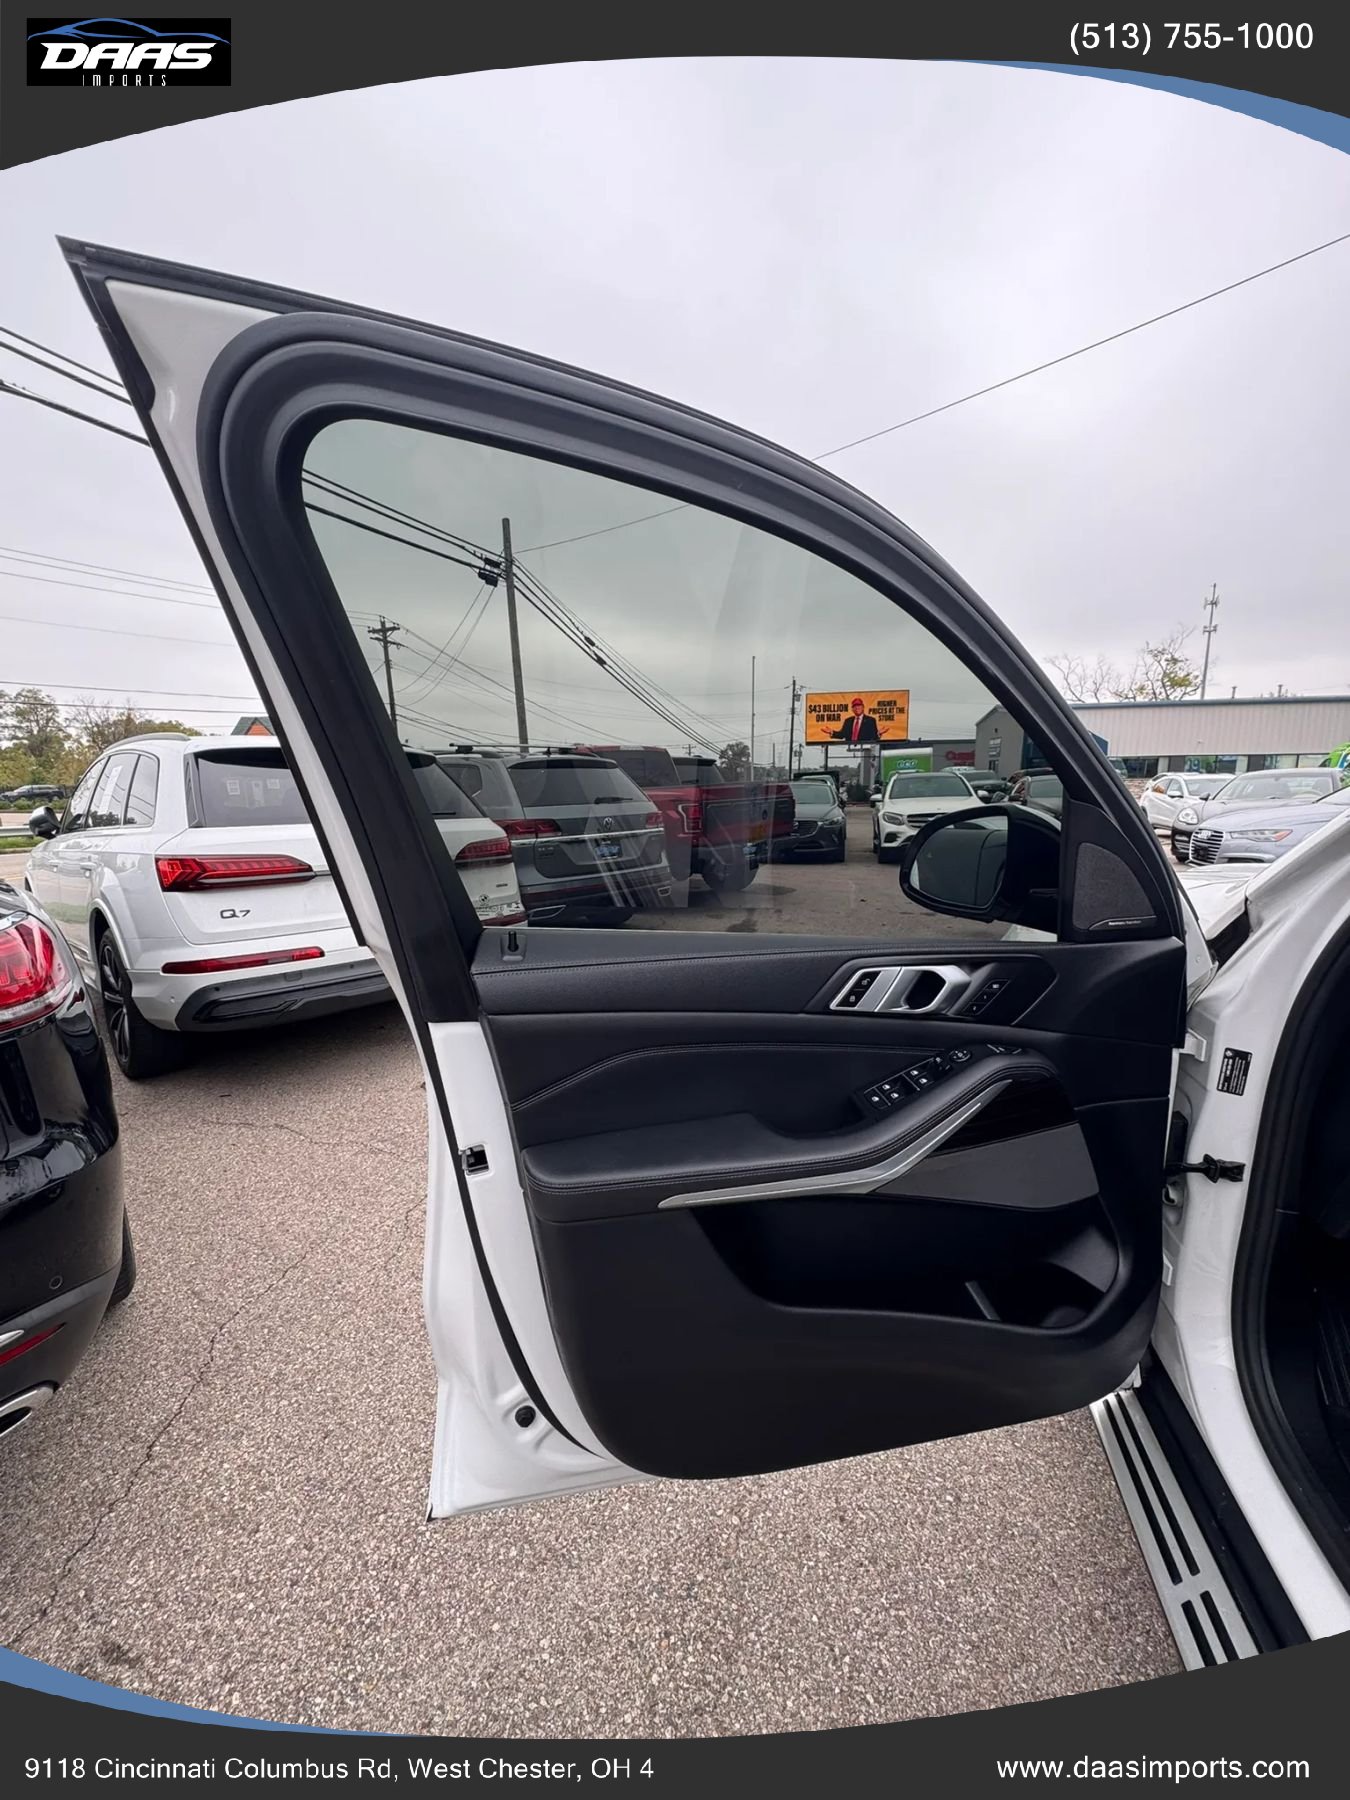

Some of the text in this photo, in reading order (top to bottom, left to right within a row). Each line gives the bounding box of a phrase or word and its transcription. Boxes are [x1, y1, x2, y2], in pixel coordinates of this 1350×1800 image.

[808, 703, 849, 714] $43 BILLION
[896, 706, 905, 714] THE
[816, 713, 841, 722] ON WAR
[878, 714, 895, 722] STORE
[220, 908, 251, 919] Q7
